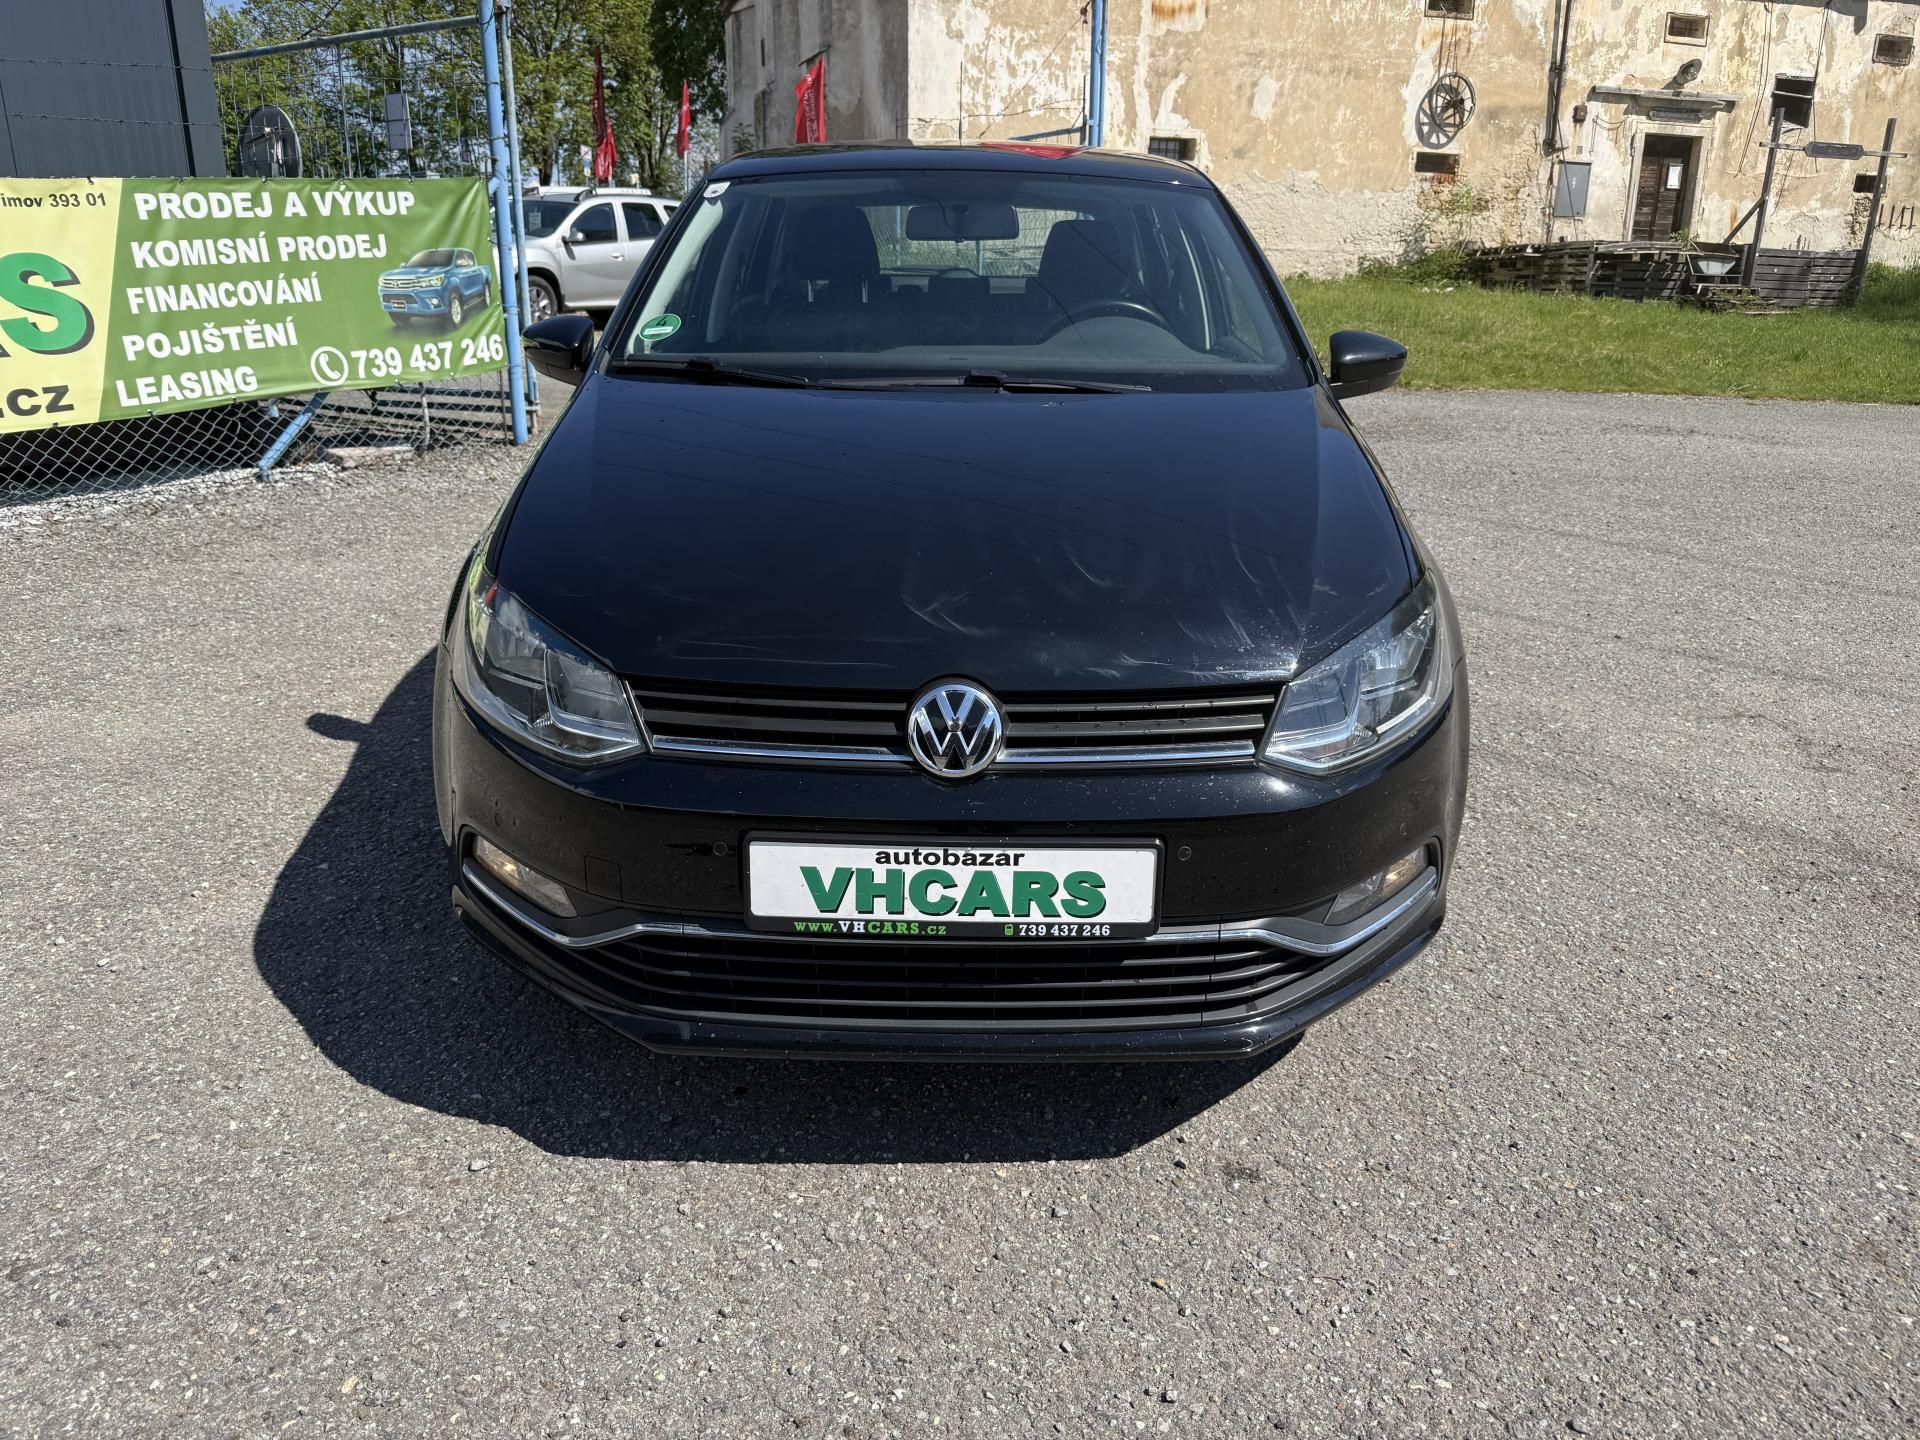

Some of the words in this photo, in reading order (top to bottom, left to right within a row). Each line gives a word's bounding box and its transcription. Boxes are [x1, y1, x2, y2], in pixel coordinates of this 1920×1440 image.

[48, 193, 81, 207] 393
[85, 192, 107, 206] 01
[134, 191, 273, 220] PRODEJ
[284, 192, 307, 217] A
[312, 185, 415, 216] VÝKUP
[130, 231, 270, 269] KOMISNÍ
[277, 233, 388, 262] PRODEJ
[0, 251, 95, 356] S
[126, 272, 322, 315] FINANCOVÁNÍ
[122, 316, 299, 361] POJIŠTĚNÍ
[351, 346, 401, 379] 739
[409, 341, 454, 373] 437
[464, 334, 504, 365] 246
[115, 366, 259, 407] LEASING
[875, 848, 1025, 867] autobazar
[800, 866, 1107, 918] VHCARS
[794, 921, 947, 936] www.VHCARS.cz
[1019, 925, 1048, 936] 739
[1051, 925, 1079, 936] 437
[1082, 924, 1111, 936] 246
